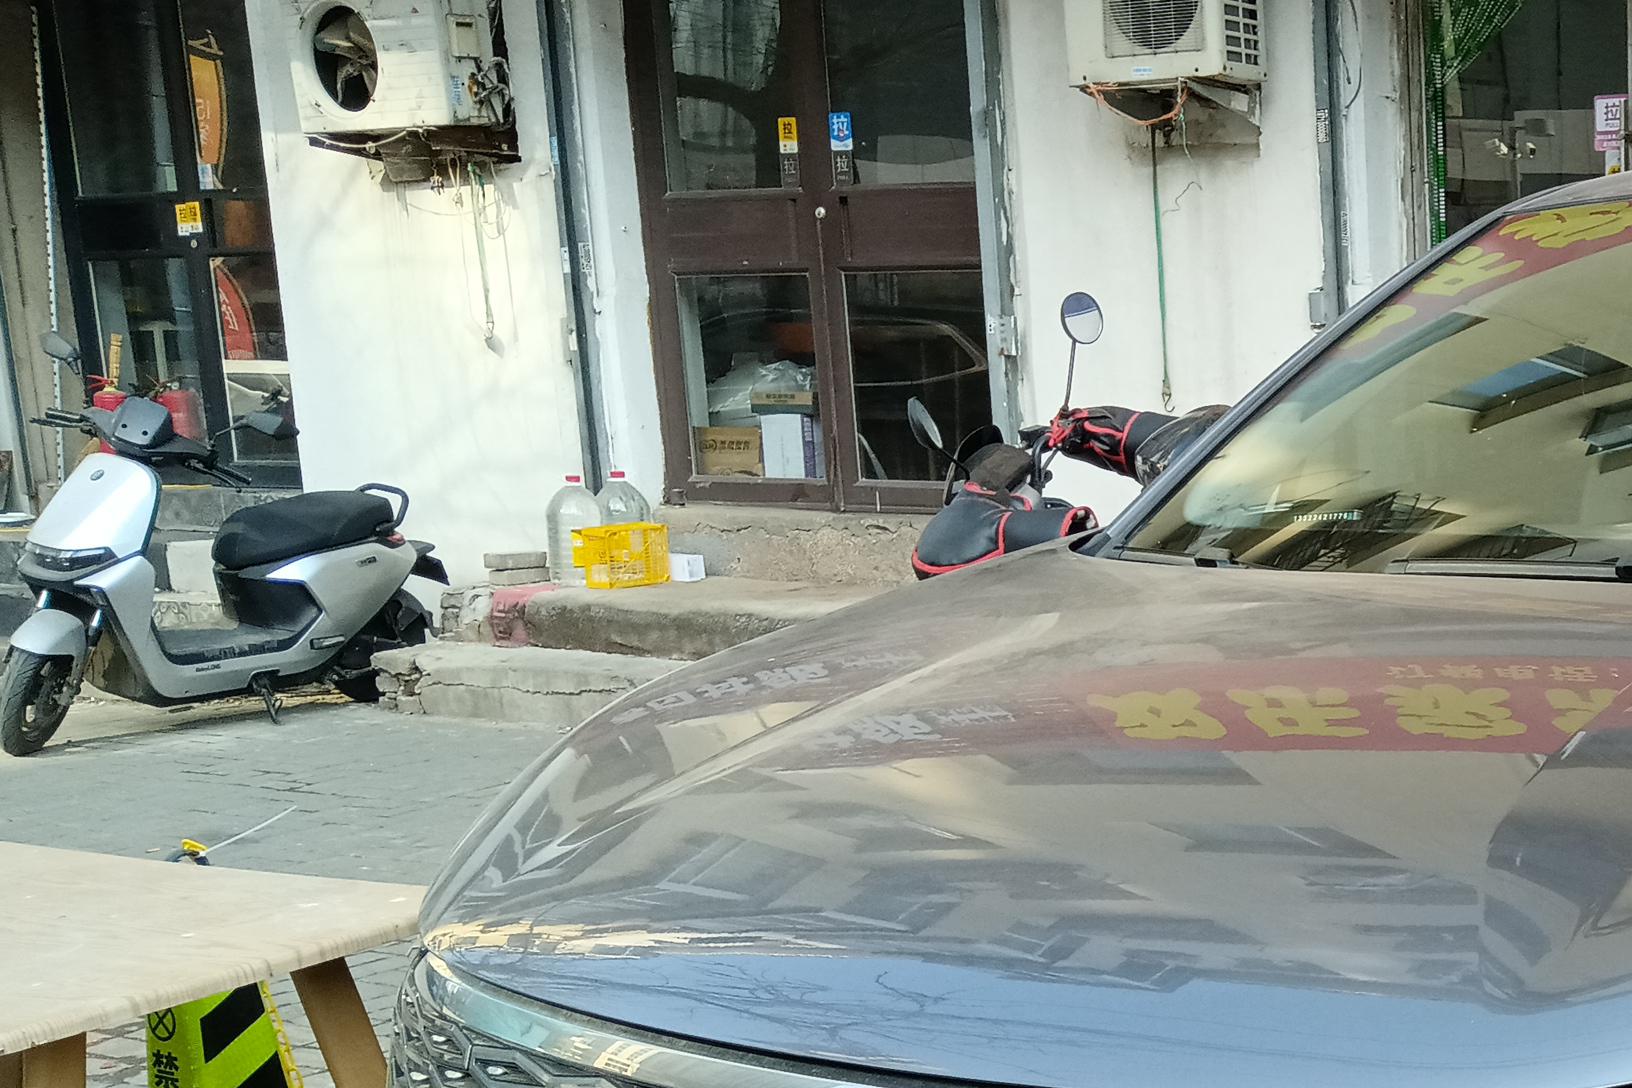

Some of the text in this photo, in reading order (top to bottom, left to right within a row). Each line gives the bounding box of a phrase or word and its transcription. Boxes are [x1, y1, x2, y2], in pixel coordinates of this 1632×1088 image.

[1604, 102, 1620, 122] 拉
[832, 115, 849, 136] 拉
[784, 158, 796, 175] 拉
[837, 155, 849, 173] 拉
